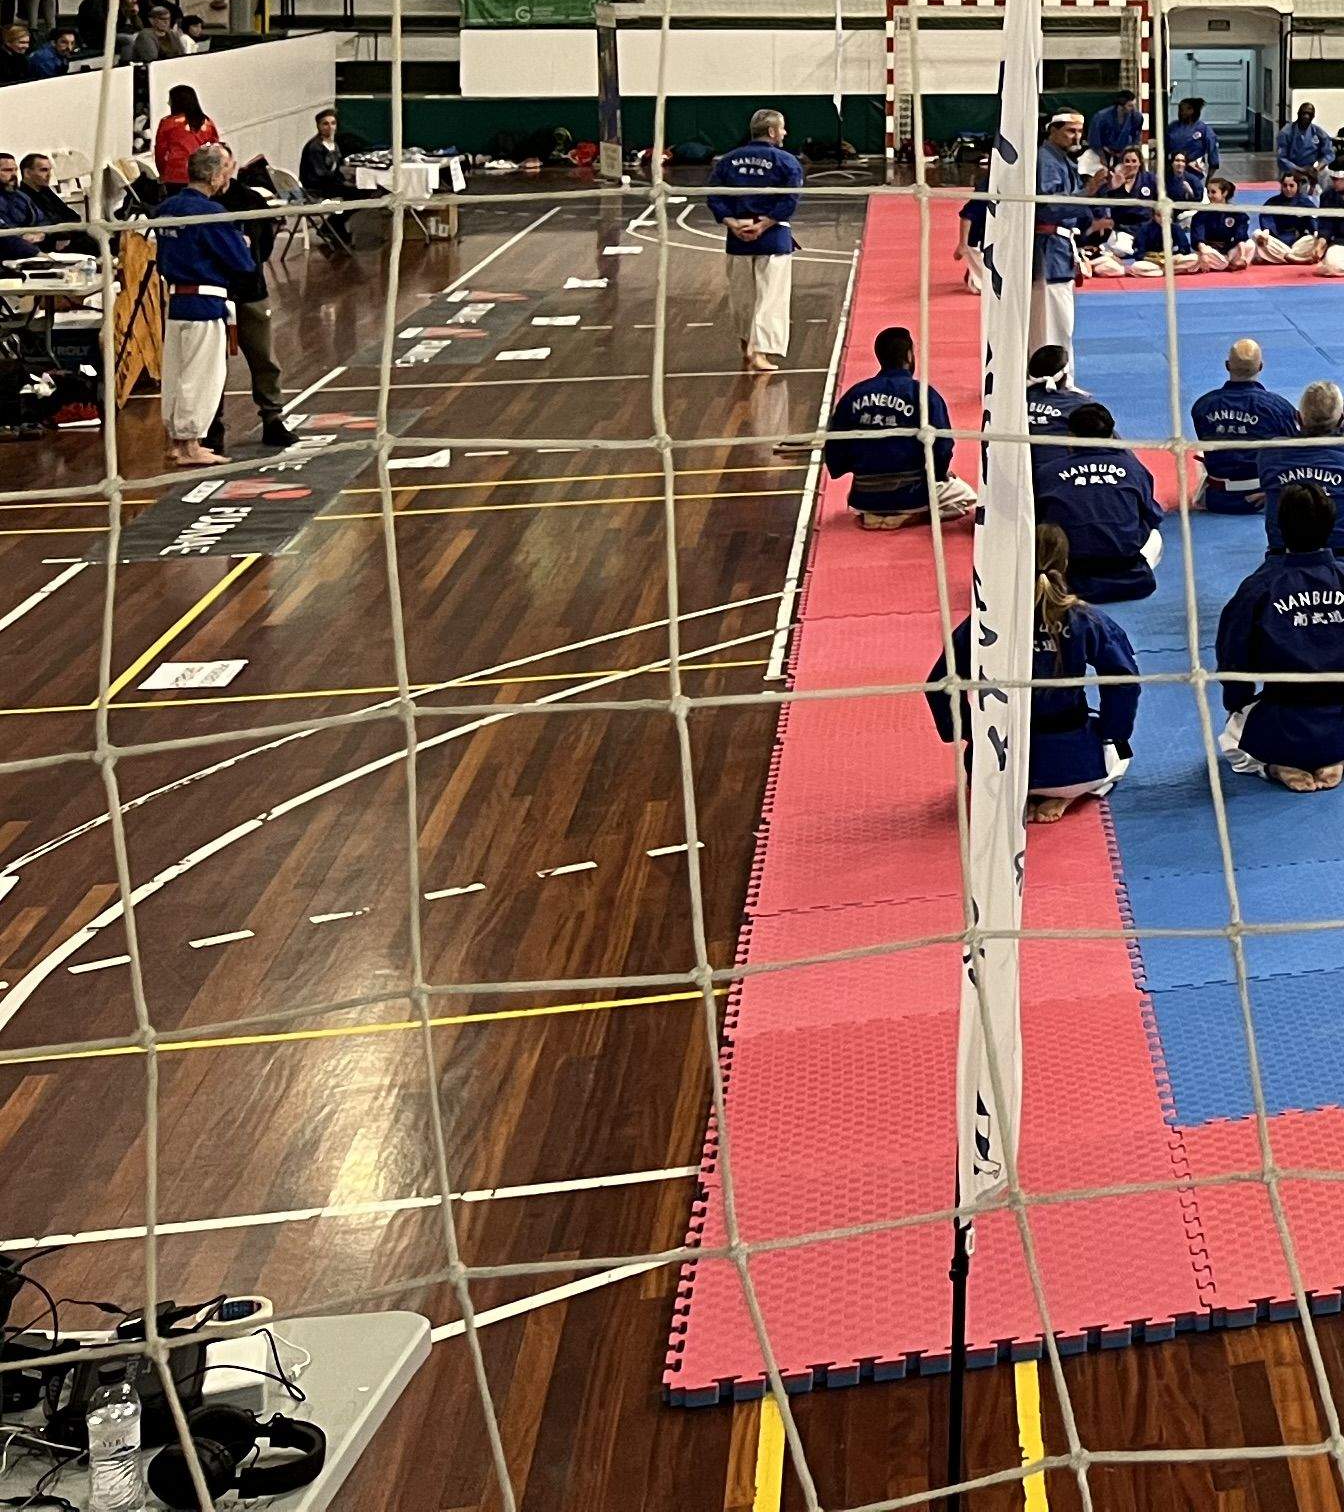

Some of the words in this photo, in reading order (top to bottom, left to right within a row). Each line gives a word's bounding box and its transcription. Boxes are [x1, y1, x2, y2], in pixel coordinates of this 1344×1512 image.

[852, 393, 914, 418] NANBUDO
[1028, 402, 1062, 418] BUDO
[1206, 409, 1259, 425] NANBUDO
[1058, 463, 1127, 481] NANBUDO
[1277, 466, 1342, 485] NANBUDO
